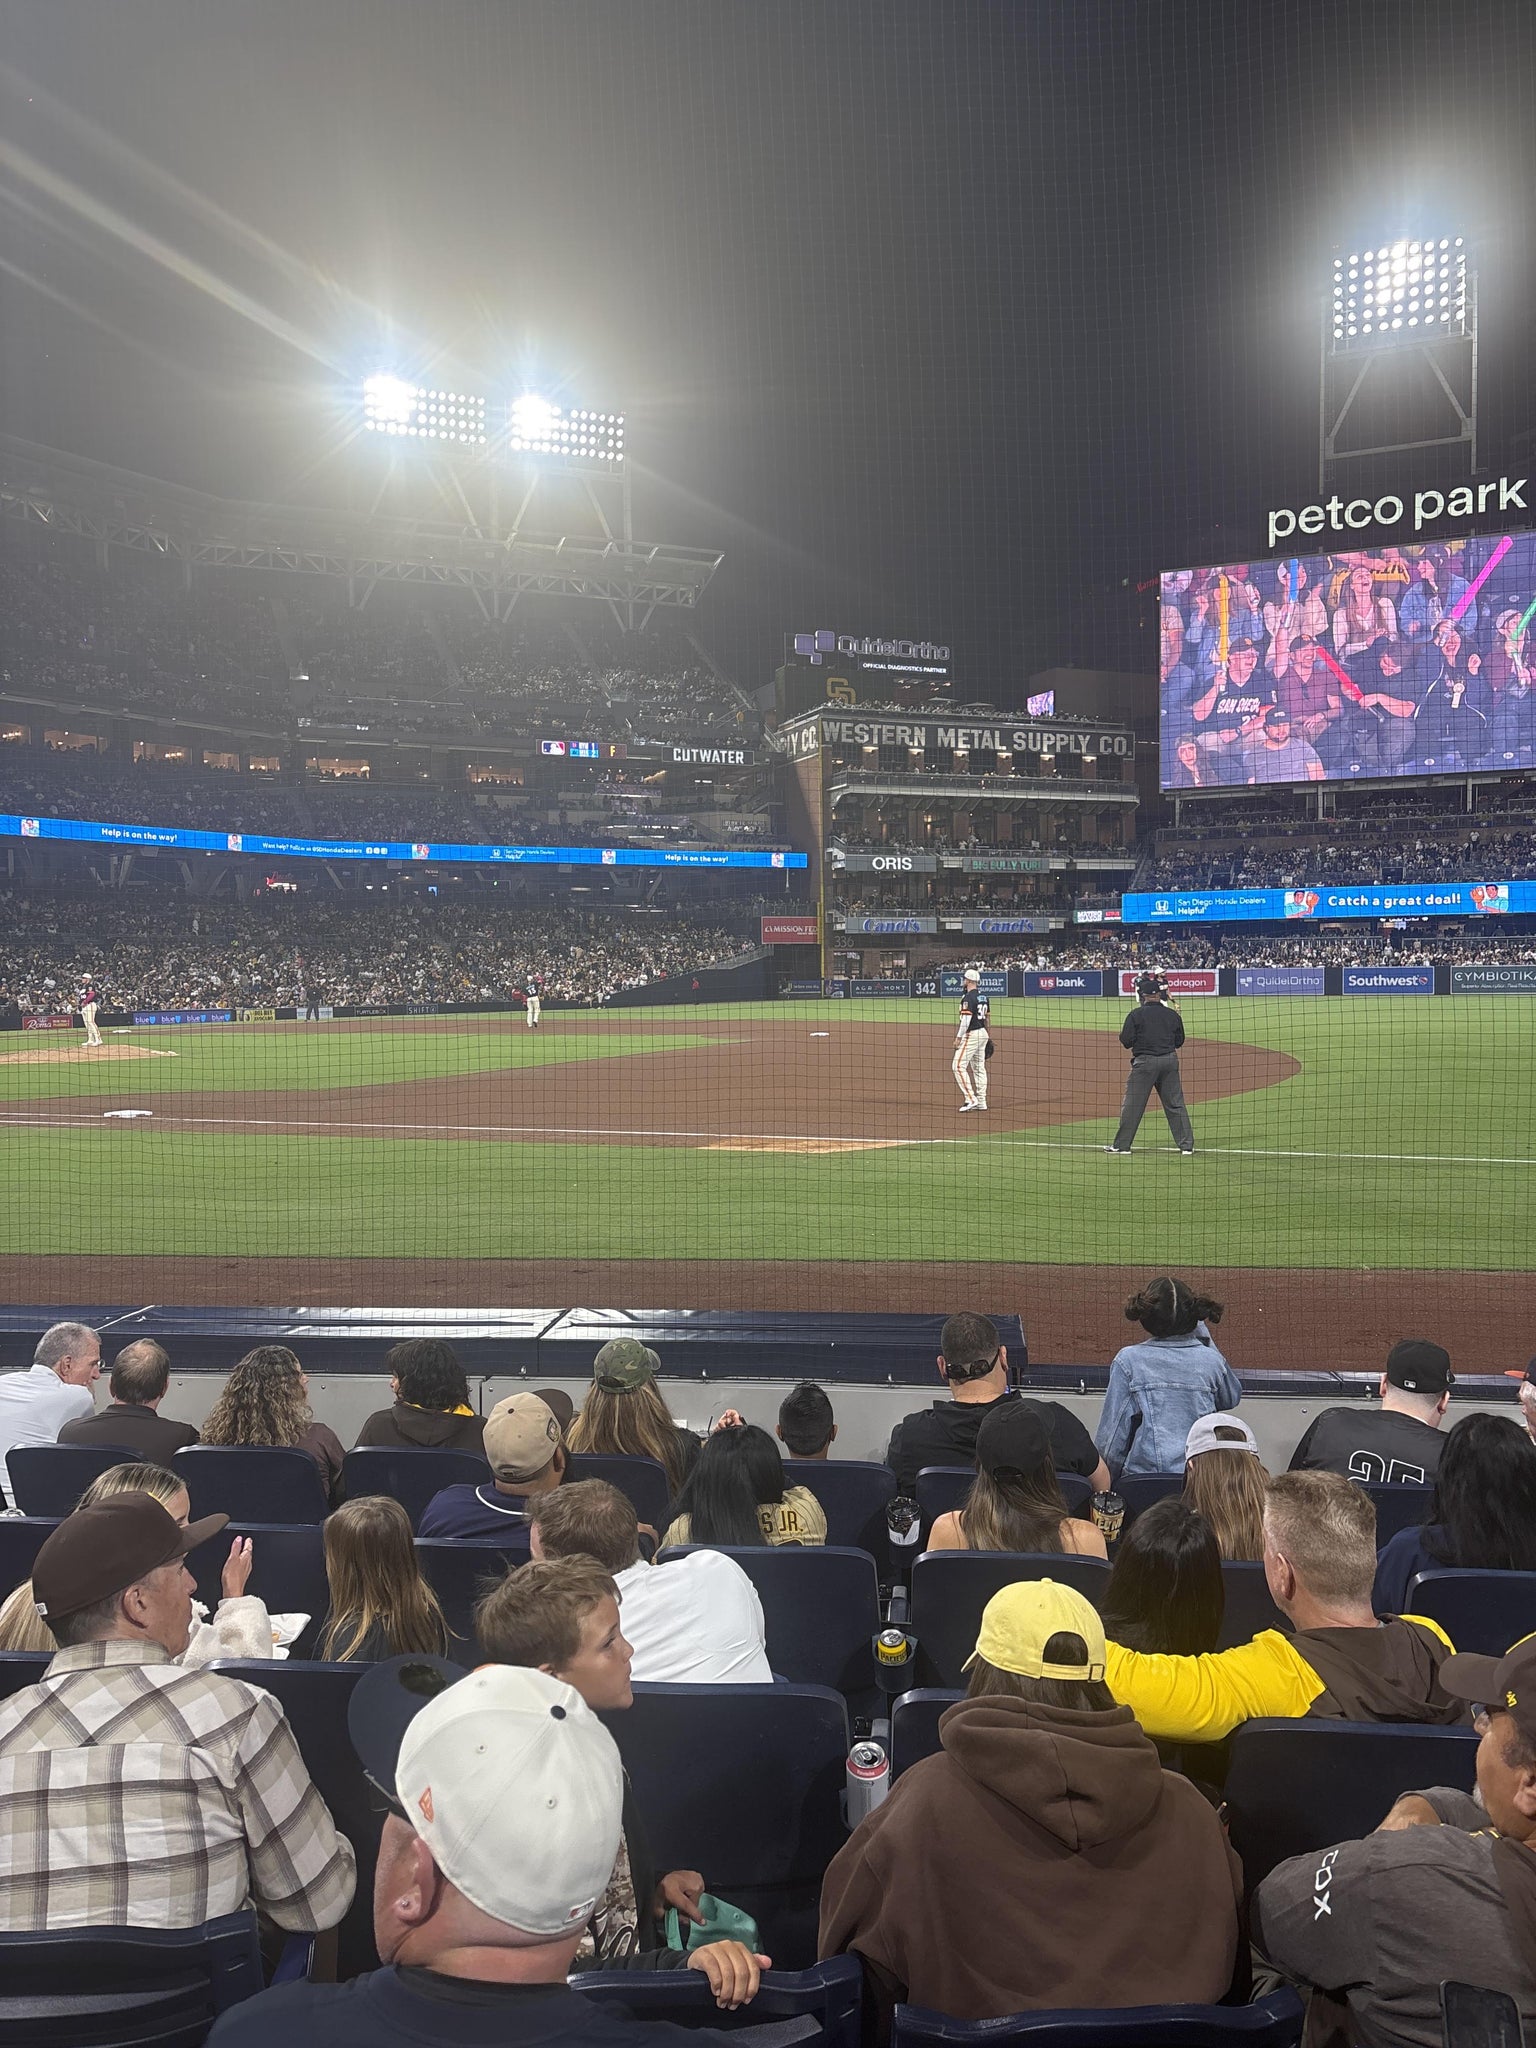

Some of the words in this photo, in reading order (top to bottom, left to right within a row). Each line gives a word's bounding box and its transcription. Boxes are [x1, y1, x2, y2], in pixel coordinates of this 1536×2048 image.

[1268, 495, 1404, 548] petco
[1414, 477, 1528, 531] park
[838, 635, 950, 661] QuidelOrtho
[887, 664, 923, 672] DIAGNOSTICS
[801, 725, 819, 752] CO.
[822, 721, 926, 747] WESTERN
[937, 727, 1007, 750] METAL
[1012, 731, 1092, 754] SUPPLY
[1099, 735, 1133, 756] CO.
[673, 748, 744, 765] CUTWATER
[101, 828, 121, 839] Help
[123, 830, 130, 838] is
[144, 832, 157, 840] the
[158, 834, 178, 843] way!
[665, 854, 681, 862] Help
[872, 857, 912, 870] ORIS
[1178, 898, 1190, 906] San
[1192, 897, 1213, 907] Diego
[1215, 897, 1238, 905] Honda
[1240, 896, 1266, 904] Dealers
[1328, 894, 1368, 907] Catch
[1372, 896, 1380, 906] a
[1383, 895, 1422, 909] great
[1425, 893, 1461, 905] deal!
[1178, 907, 1205, 916] Helpful
[773, 925, 803, 933] MISSION
[863, 918, 921, 932] Canel's
[980, 918, 1034, 933] Canel's
[833, 936, 855, 948] 336
[1039, 978, 1055, 988] us
[1056, 976, 1085, 988] bank
[1256, 976, 1320, 985] QuidelOrtho
[1348, 974, 1419, 986] Southwest
[915, 982, 936, 994] 342
[977, 1004, 988, 1020] 30
[161, 1015, 175, 1023] blue
[780, 1510, 804, 1532] JR.
